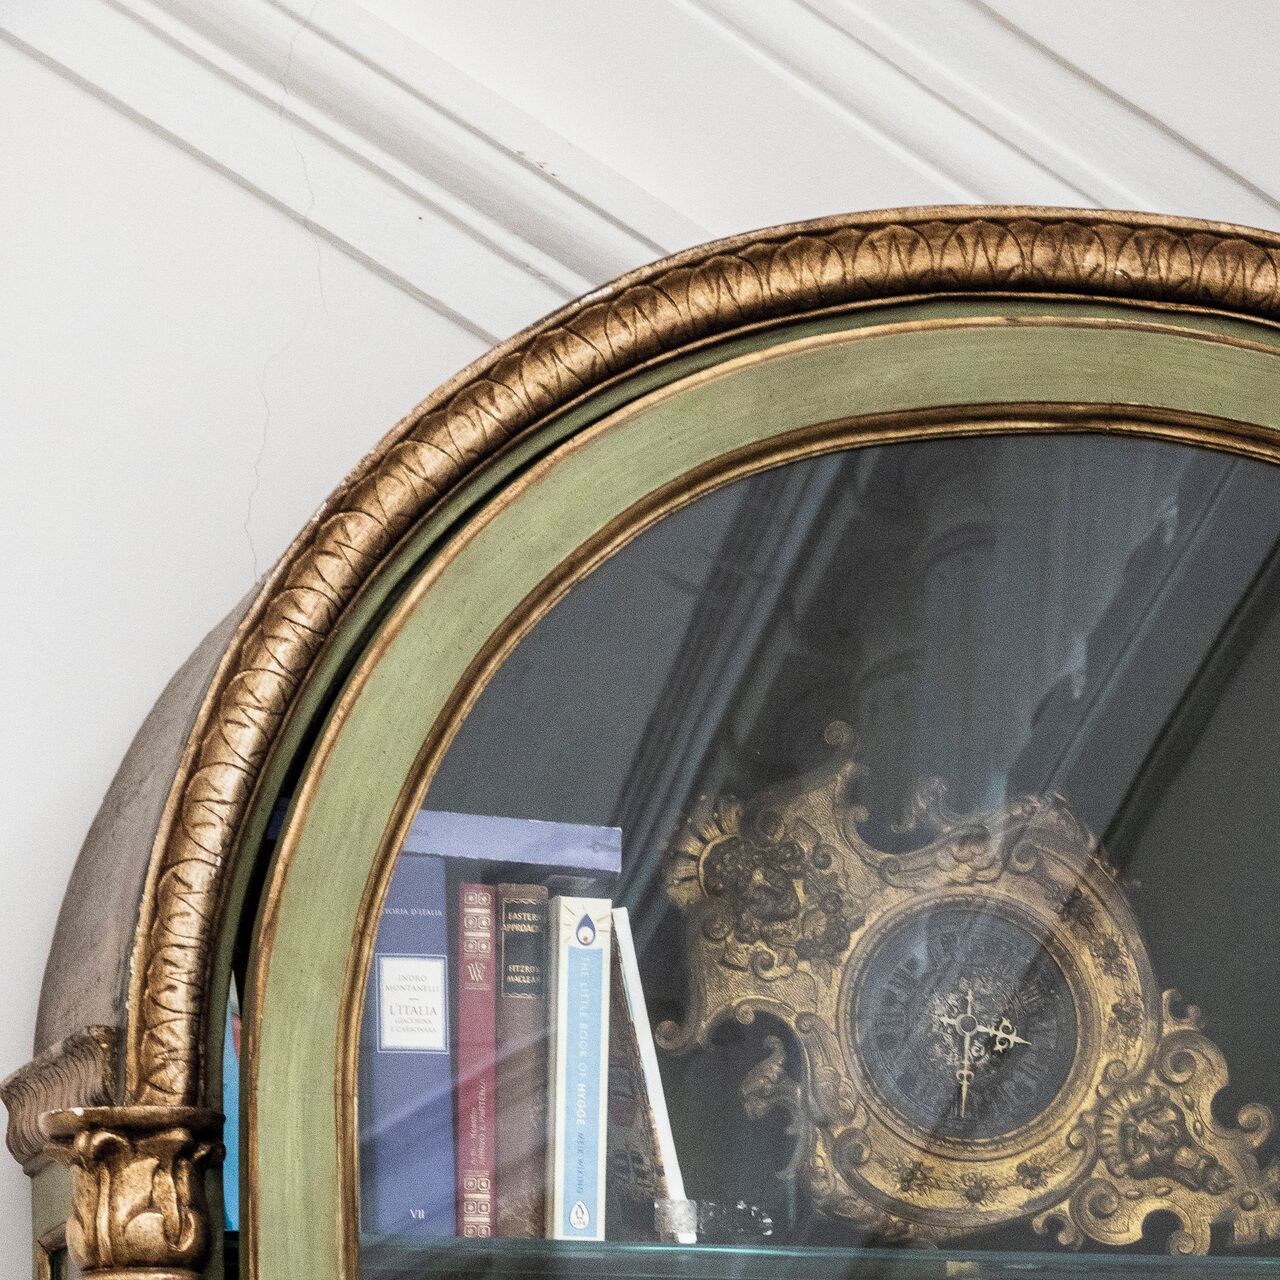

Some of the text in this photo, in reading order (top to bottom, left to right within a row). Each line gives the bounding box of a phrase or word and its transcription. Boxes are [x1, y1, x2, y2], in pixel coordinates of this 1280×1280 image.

[382, 907, 409, 916] TORIA
[398, 973, 428, 983] INDRO
[385, 983, 440, 993] MONTANELLI
[389, 1001, 438, 1017] L'ITALIA
[579, 1022, 589, 1057] BOOK
[578, 1062, 588, 1078] OF
[576, 1083, 586, 1126] HYGGE
[410, 1209, 425, 1220] VII
